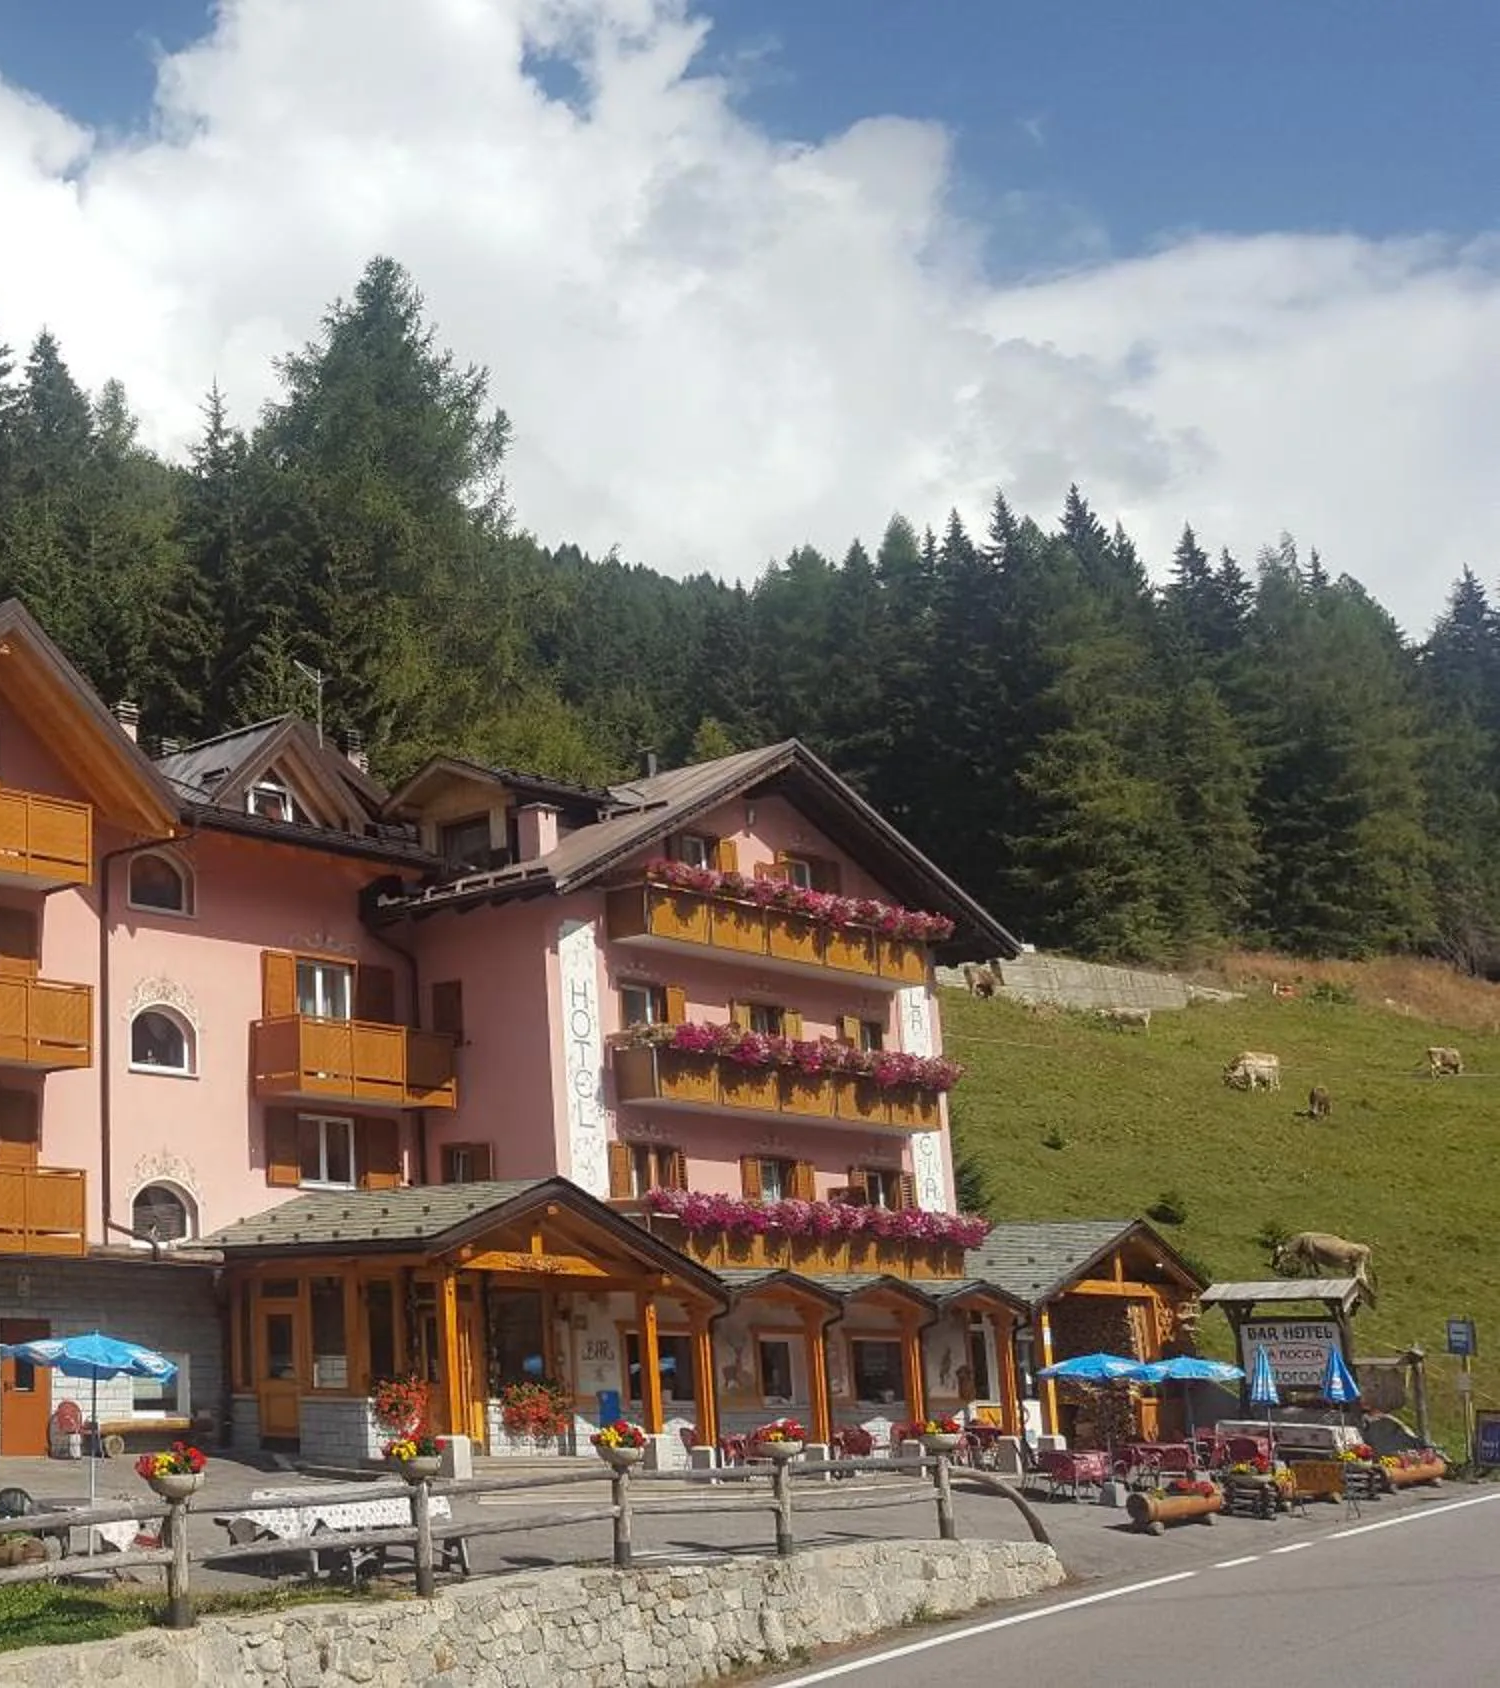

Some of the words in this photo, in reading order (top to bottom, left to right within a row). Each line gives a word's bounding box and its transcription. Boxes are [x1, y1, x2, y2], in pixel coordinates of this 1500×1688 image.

[570, 978, 596, 1128] HOTEL
[909, 989, 923, 1030] LA
[919, 1135, 938, 1200] CIA
[1247, 1327, 1278, 1340] BAR
[1283, 1325, 1333, 1339] HOTEL
